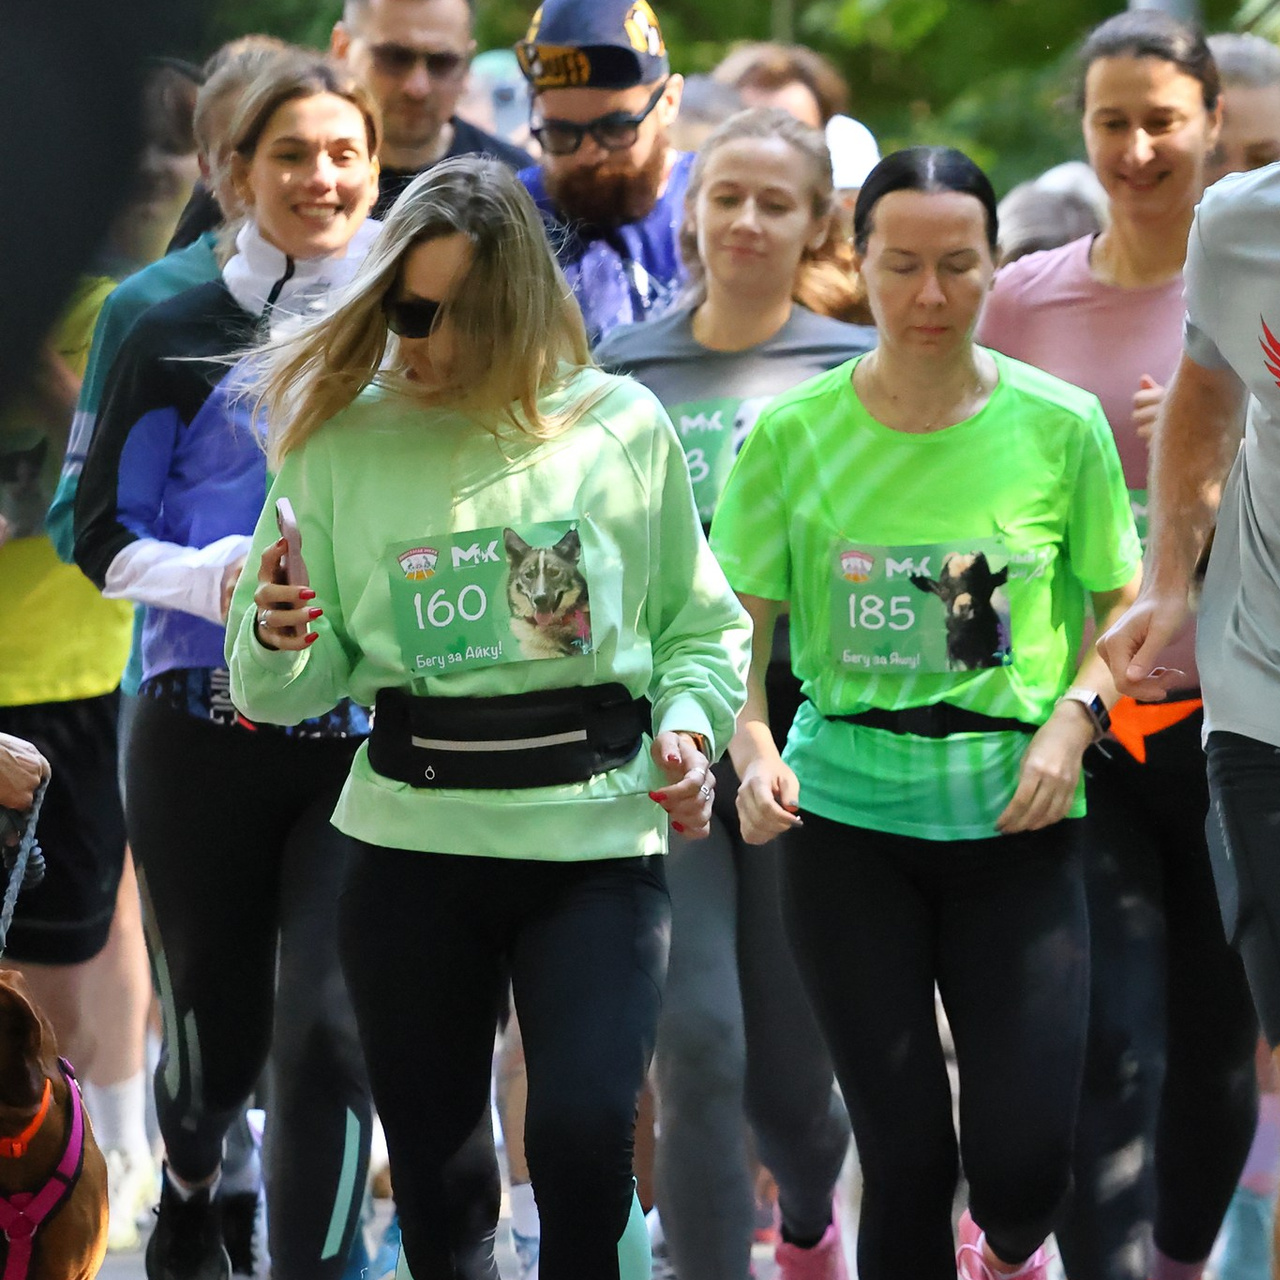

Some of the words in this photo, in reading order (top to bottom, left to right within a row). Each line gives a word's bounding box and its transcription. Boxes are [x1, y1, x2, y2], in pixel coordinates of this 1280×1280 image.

[413, 584, 487, 630] 160
[848, 592, 916, 631] 185
[416, 654, 446, 669] Бегу
[447, 652, 463, 664] за
[465, 640, 502, 660] Айку!
